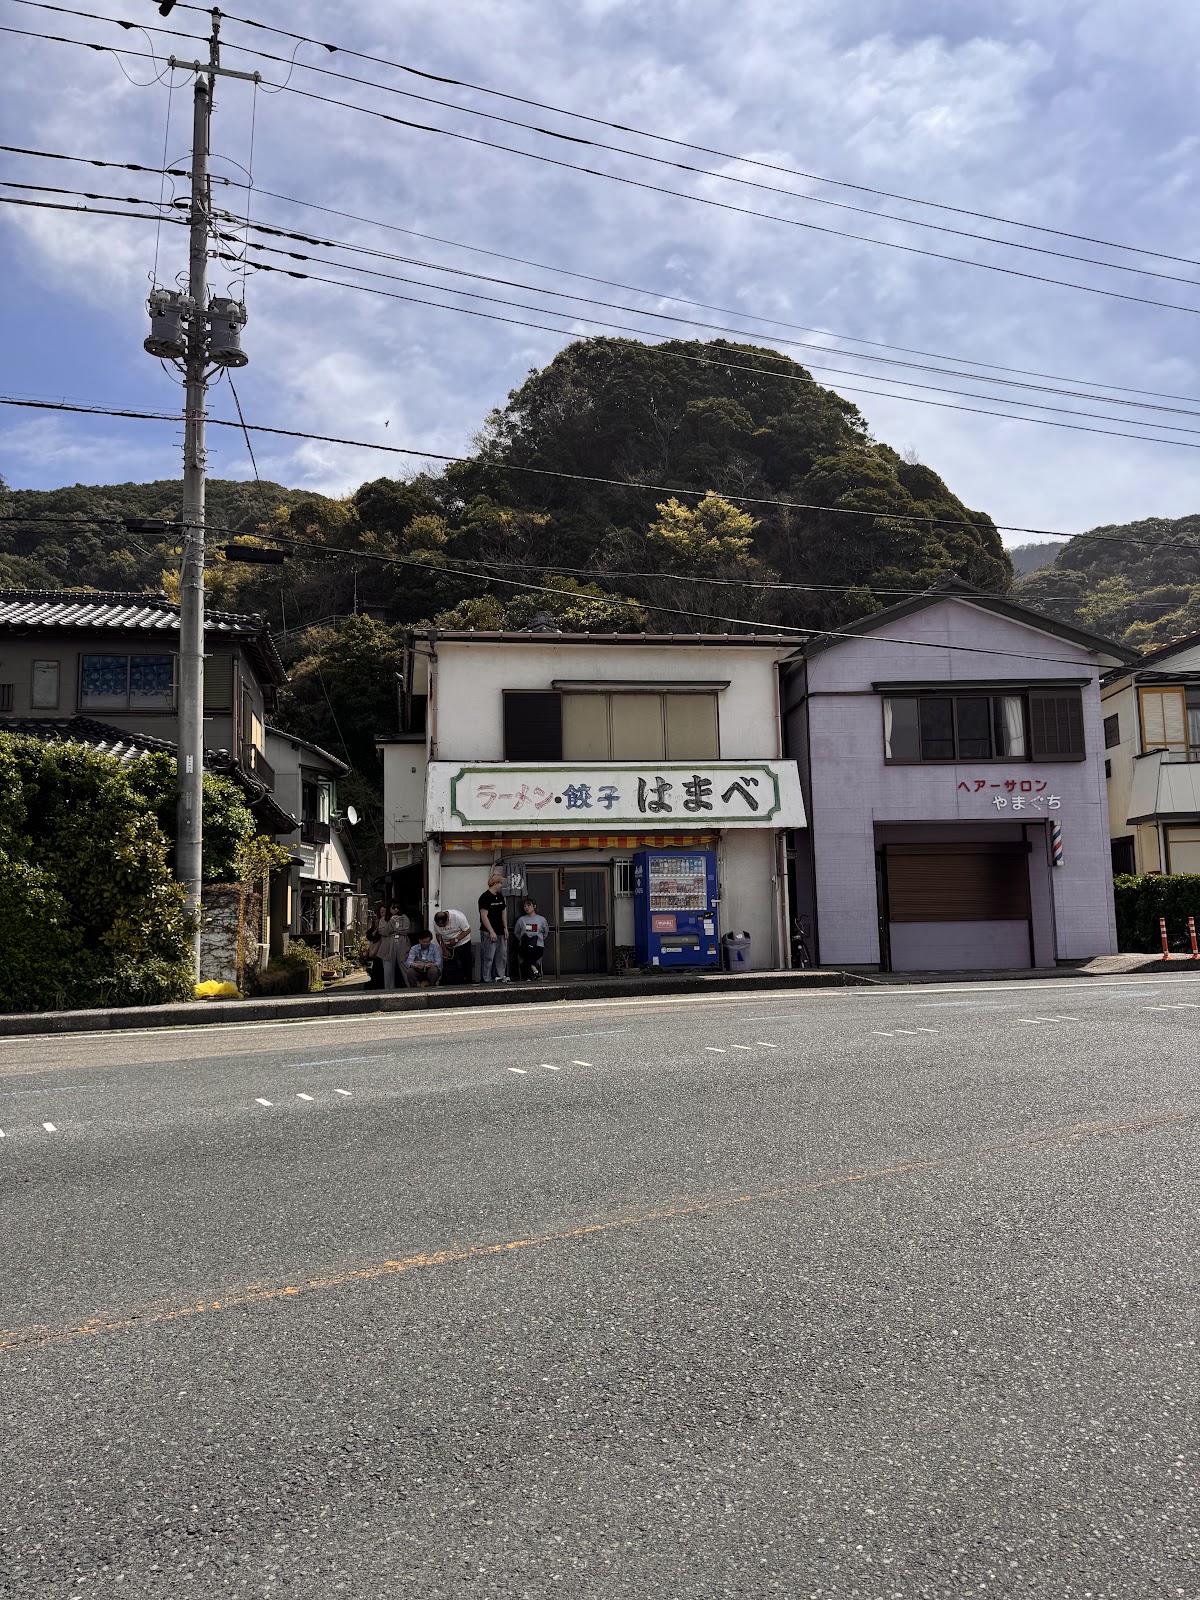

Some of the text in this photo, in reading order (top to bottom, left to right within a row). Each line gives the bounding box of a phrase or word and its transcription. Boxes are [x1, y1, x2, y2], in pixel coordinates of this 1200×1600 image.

[637, 774, 760, 813] はまべ
[958, 779, 1048, 793] ヘアーサロン
[992, 794, 1061, 811] やまぐち
